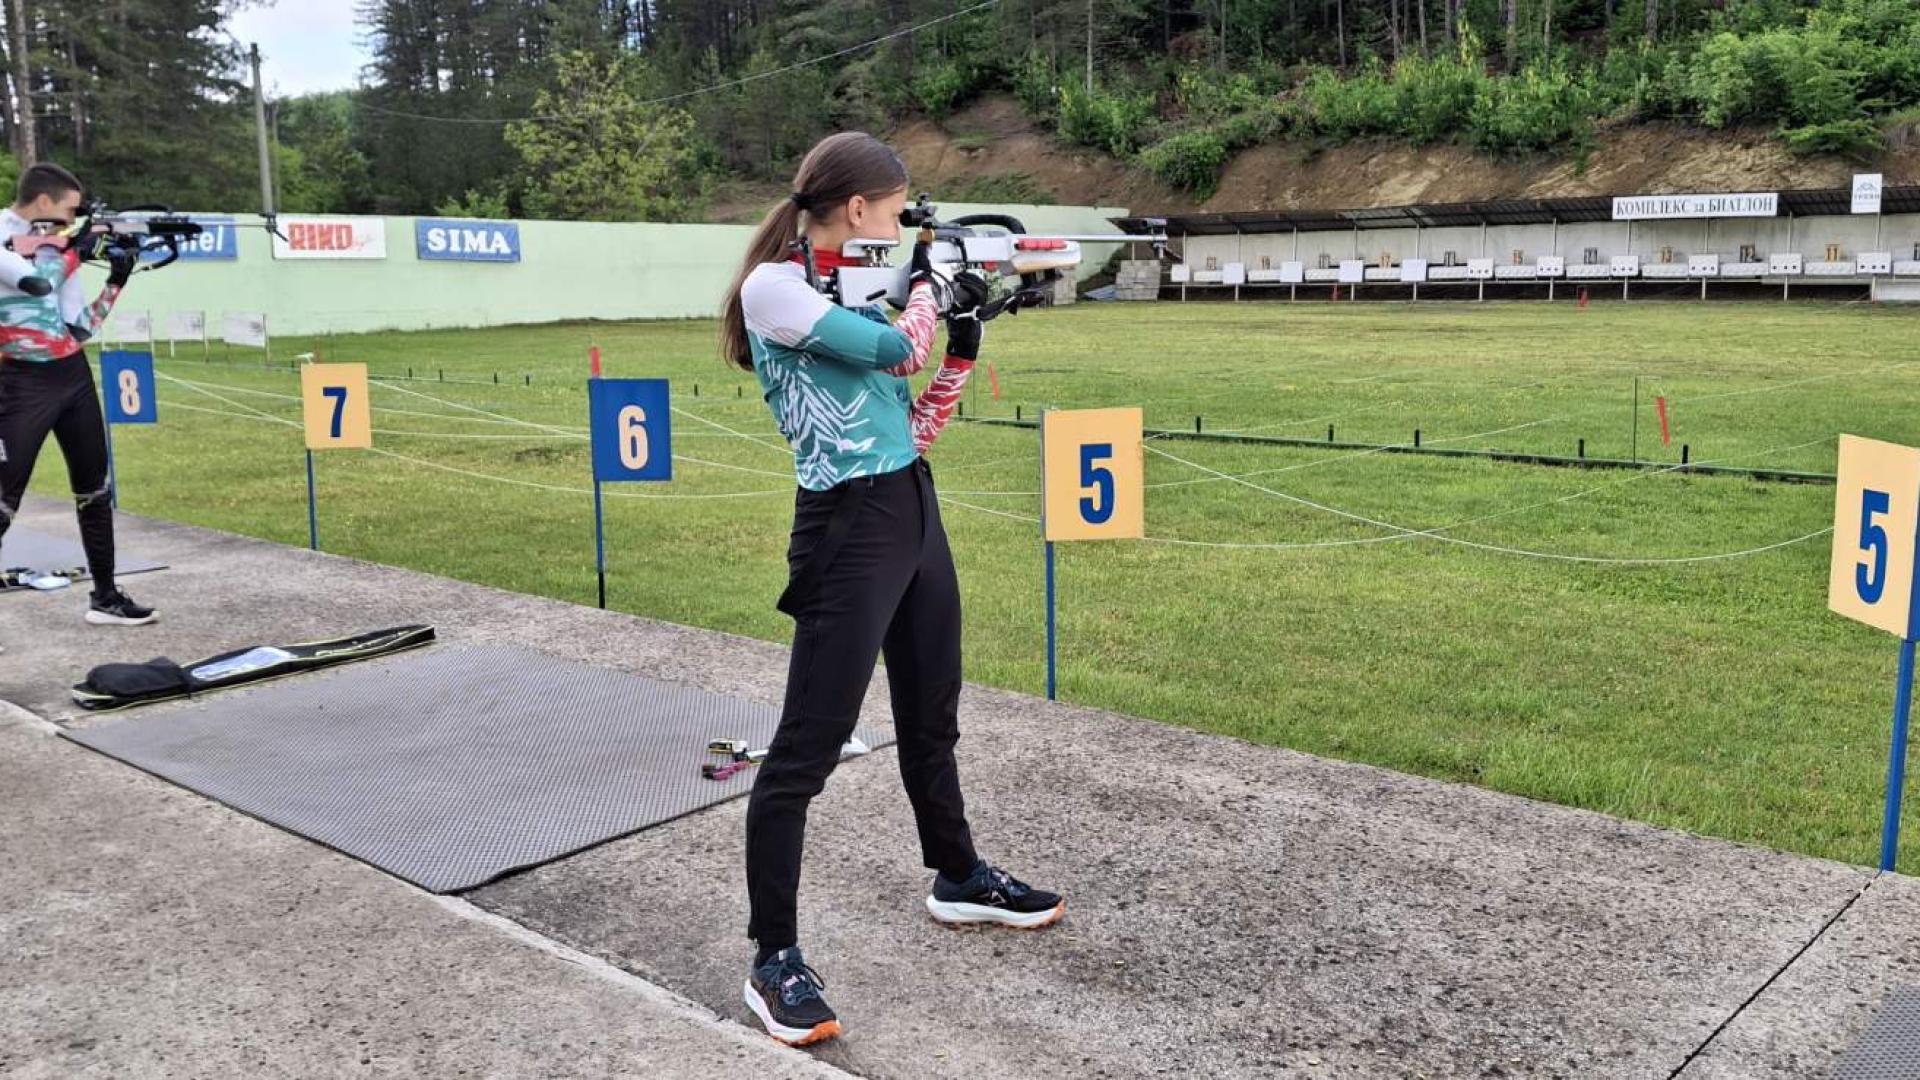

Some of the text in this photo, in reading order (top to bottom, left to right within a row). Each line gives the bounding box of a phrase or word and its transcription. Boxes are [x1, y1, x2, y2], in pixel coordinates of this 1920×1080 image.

[1616, 200, 1690, 216] КОМПЛЕКС
[1709, 197, 1773, 213] БИАТЛОН
[427, 227, 512, 254] SIMA
[118, 369, 141, 415] 8
[322, 386, 347, 437] 7
[618, 405, 648, 470] 6
[1079, 443, 1114, 524] 5
[1855, 488, 1890, 605] 5
